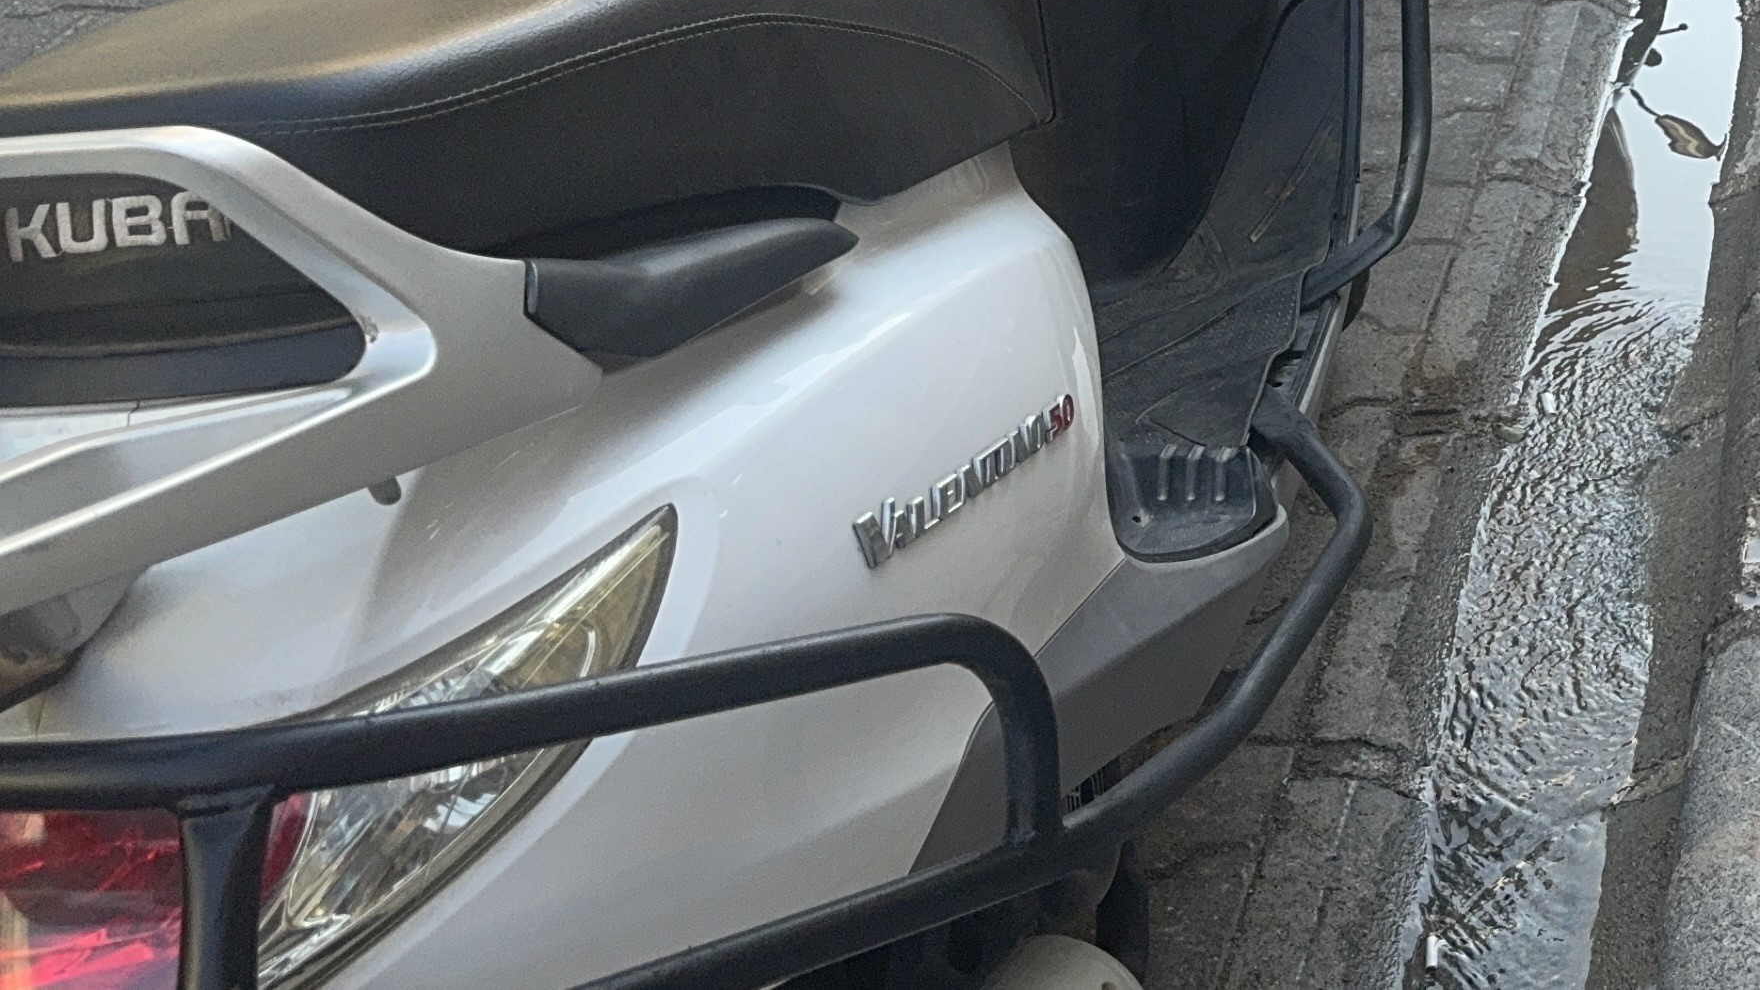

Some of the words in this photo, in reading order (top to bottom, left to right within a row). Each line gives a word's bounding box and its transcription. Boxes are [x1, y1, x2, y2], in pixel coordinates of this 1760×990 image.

[5, 191, 225, 262] KUBA
[852, 415, 1045, 568] VALENTINO
[1042, 393, 1075, 443] 50
